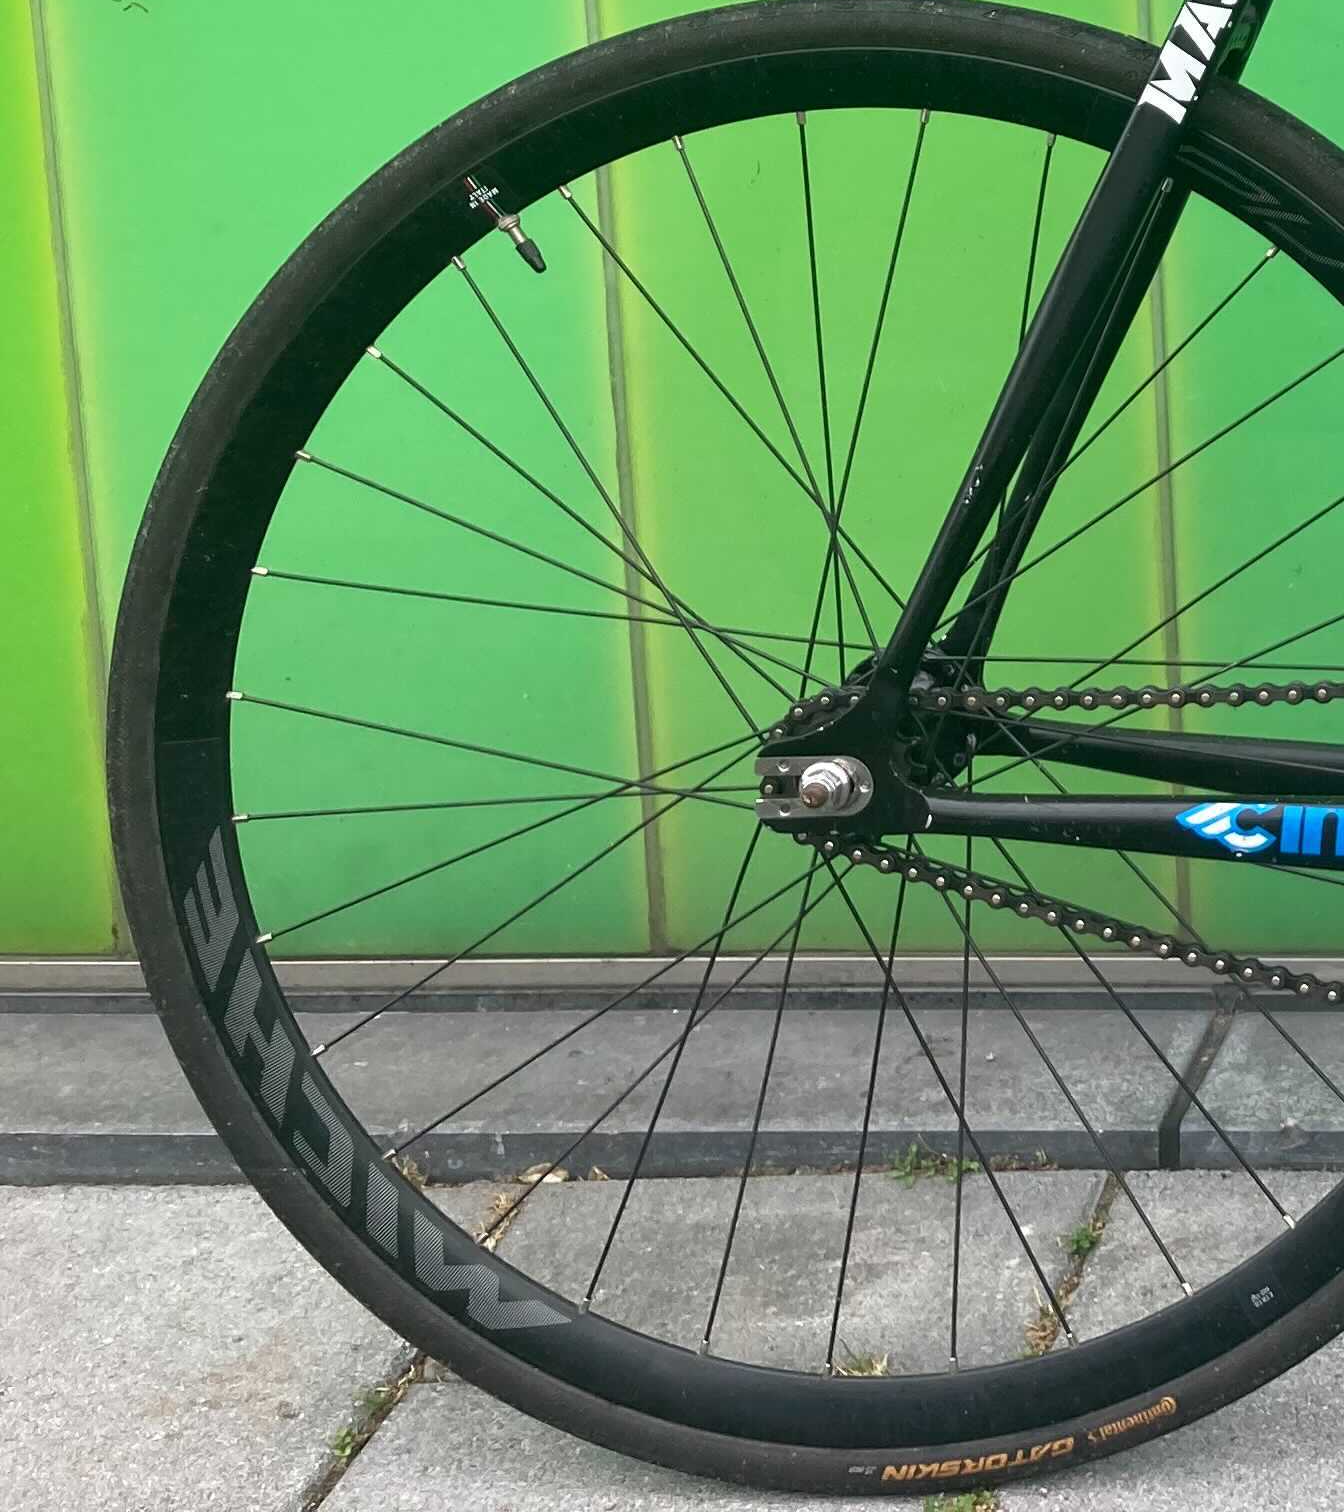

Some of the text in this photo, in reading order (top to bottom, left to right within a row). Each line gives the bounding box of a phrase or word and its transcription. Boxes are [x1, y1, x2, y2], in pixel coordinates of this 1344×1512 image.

[183, 825, 572, 1330] MICHE
[880, 1396, 1178, 1482] Continental GATORSKIN
